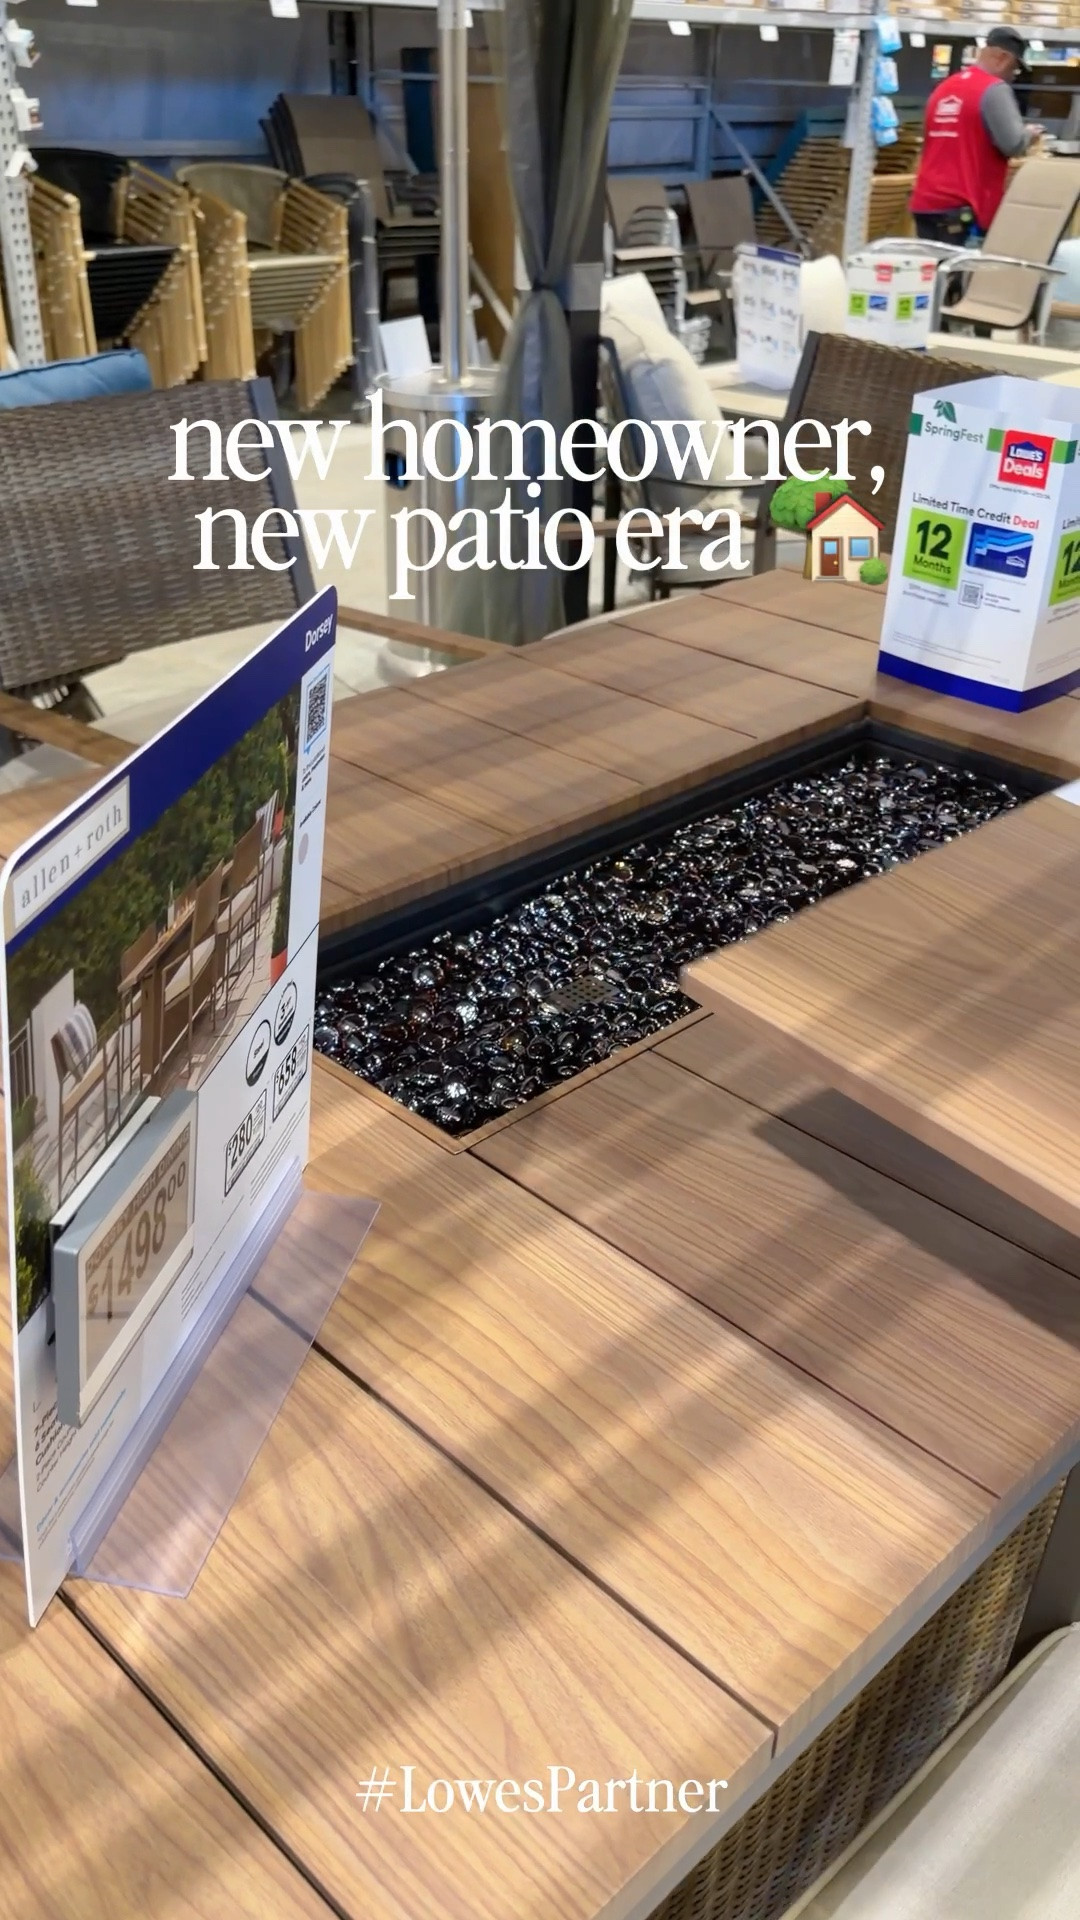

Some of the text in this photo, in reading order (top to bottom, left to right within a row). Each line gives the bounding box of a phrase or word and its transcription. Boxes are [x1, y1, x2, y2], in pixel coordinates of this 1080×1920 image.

[924, 421, 985, 444] SpringFest
[1003, 459, 1045, 480] Deals
[912, 492, 1040, 531] Limited Time Credit Deal
[916, 519, 953, 561] 12
[912, 554, 952, 576] Months
[304, 613, 334, 653] Dorsey
